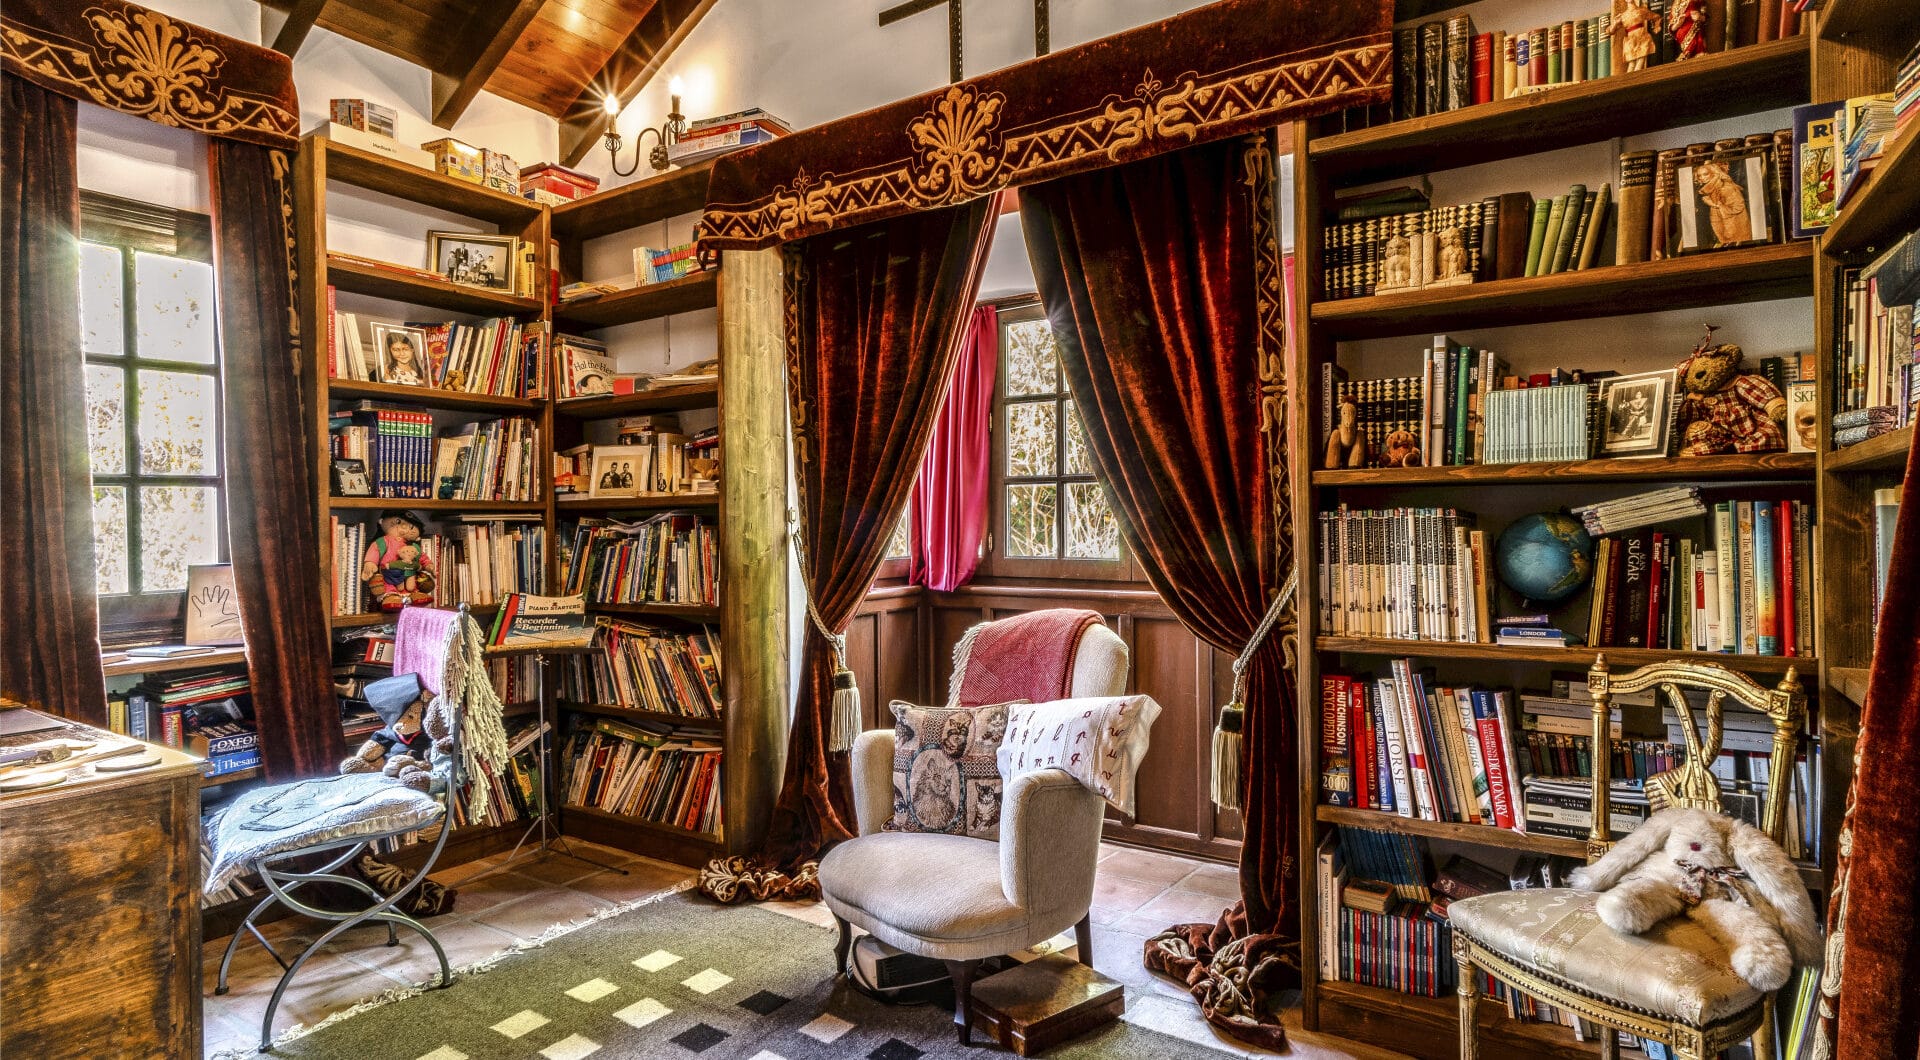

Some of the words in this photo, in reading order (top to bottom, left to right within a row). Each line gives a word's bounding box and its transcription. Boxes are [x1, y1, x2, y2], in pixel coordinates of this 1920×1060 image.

[573, 361, 586, 371] Hal
[587, 360, 599, 370] the
[1721, 539, 1729, 562] PETER
[1742, 537, 1751, 549] The
[1627, 539, 1640, 583] SUGAR
[1722, 564, 1731, 578] PAN
[1743, 551, 1752, 570] World
[1744, 580, 1754, 631] Winnie-the-Pooh
[515, 617, 558, 625] Recorder
[522, 624, 570, 633] Beginning
[1337, 680, 1345, 691] The
[1323, 679, 1335, 744] ENCYCLOPEDIA
[1355, 699, 1361, 708] 2
[1372, 687, 1383, 716] TIMELINES
[1336, 691, 1346, 746] HUTCHINSON
[1375, 722, 1384, 743] WORLD
[1451, 721, 1465, 758] PINOCCHIO
[1367, 732, 1375, 761] ROMAN
[1377, 743, 1385, 768] HISTORY
[1388, 731, 1405, 785] HORSE
[1322, 774, 1348, 790] 2000
[1368, 762, 1376, 790] WORLD
[1487, 758, 1508, 817] DICTIONARY
